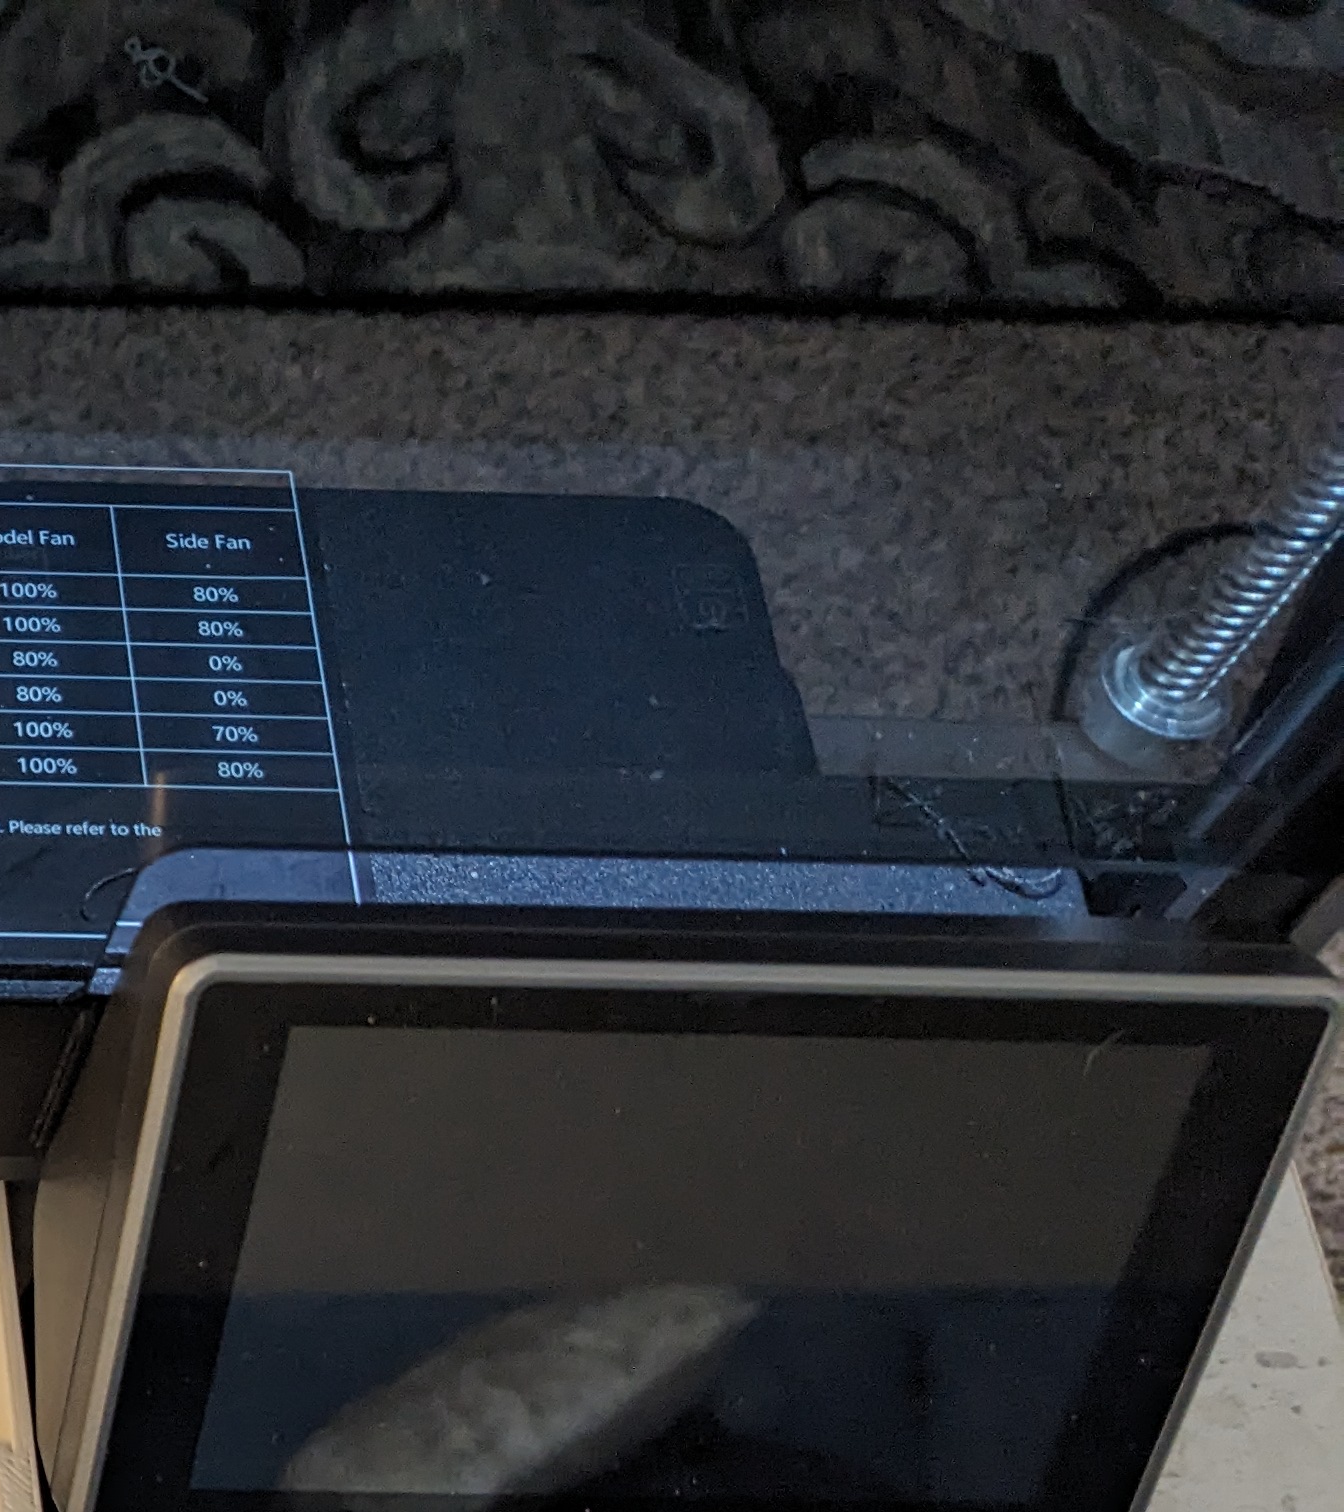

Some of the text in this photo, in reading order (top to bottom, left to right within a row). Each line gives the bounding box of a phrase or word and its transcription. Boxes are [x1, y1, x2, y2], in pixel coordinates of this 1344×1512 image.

[38, 530, 75, 546] Fan
[165, 533, 251, 550] Side Fan
[0, 582, 58, 599] 100%
[193, 586, 239, 603] 80%
[2, 616, 61, 633] 100%
[198, 620, 244, 637] 80%
[12, 651, 59, 667] 80%
[208, 655, 243, 672] 0%
[16, 685, 62, 703] 80%
[213, 690, 248, 707] 0%
[13, 721, 73, 739] 100%
[211, 725, 259, 743] 70%
[17, 757, 78, 775] 100%
[217, 761, 264, 779] 80%
